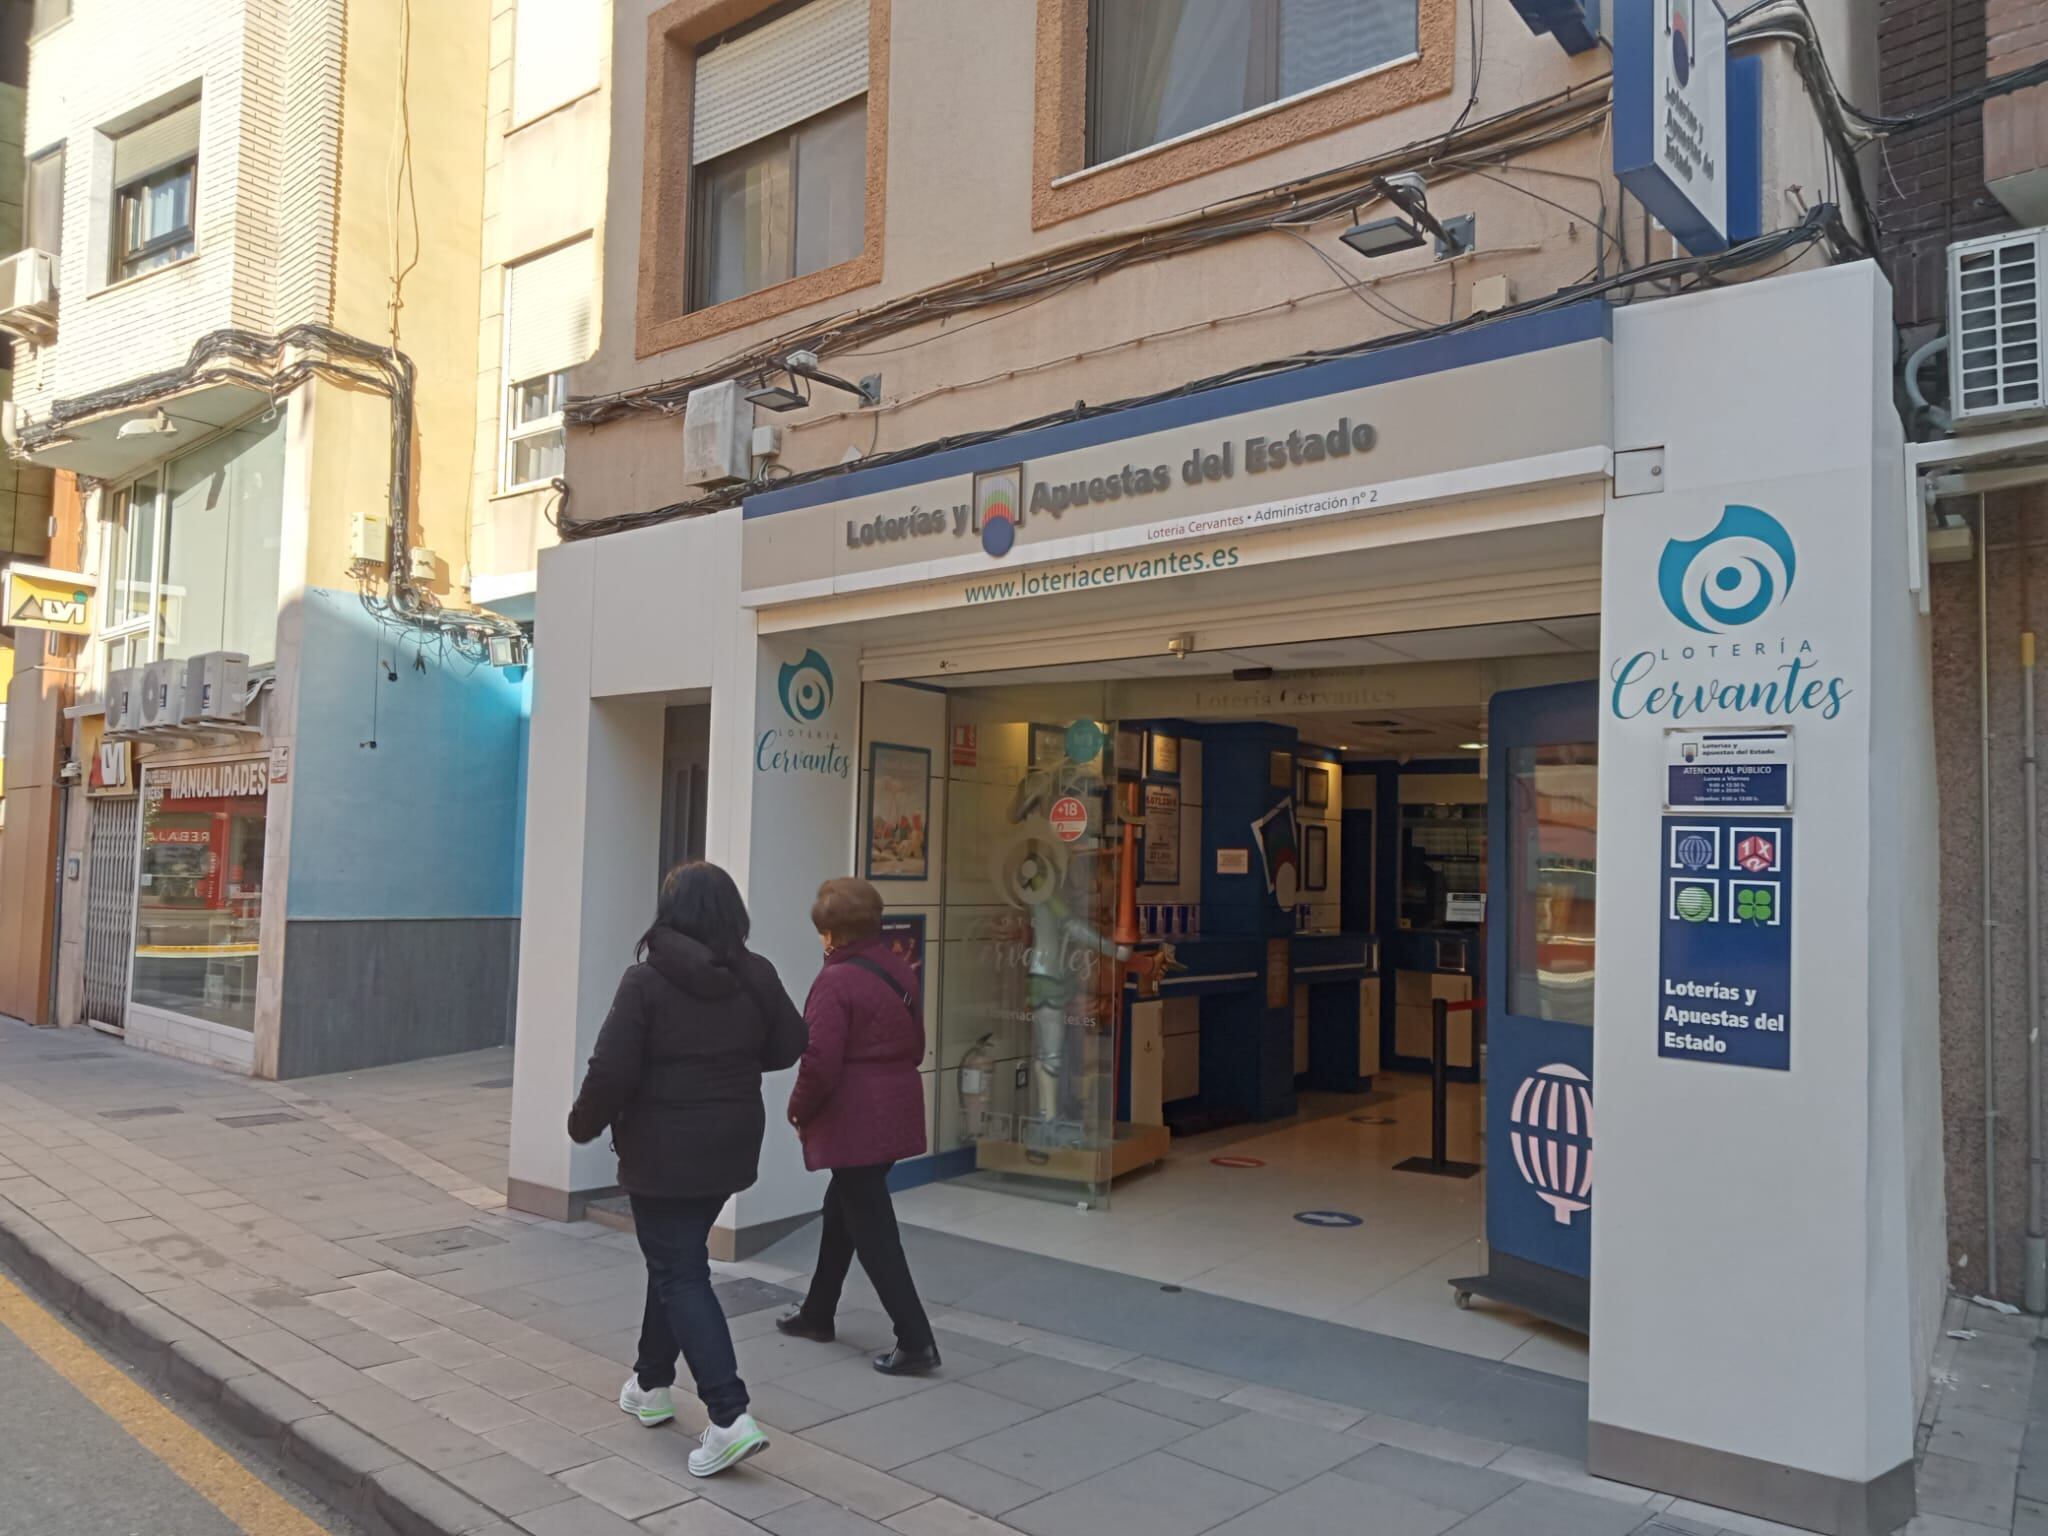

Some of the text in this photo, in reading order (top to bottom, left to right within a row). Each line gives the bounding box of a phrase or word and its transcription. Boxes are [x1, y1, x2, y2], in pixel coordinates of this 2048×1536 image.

[846, 417, 1377, 548] Loterías y Apuestas del Estado
[1188, 515, 1244, 535] Cervantes
[1254, 496, 1348, 522] Administración
[1370, 490, 1378, 503] 2
[964, 545, 1239, 603] www.loteriacervantes.es
[1661, 637, 1812, 660] LOTERÍA
[1610, 651, 1853, 720] Cervantes
[756, 729, 852, 779] Cervantes
[171, 762, 266, 800] MANUALIDADES
[1057, 802, 1078, 817] +18
[1665, 979, 1757, 1006] Loterías y
[1664, 1005, 1785, 1032] Apuestas del
[1664, 1032, 1727, 1053] Estado
